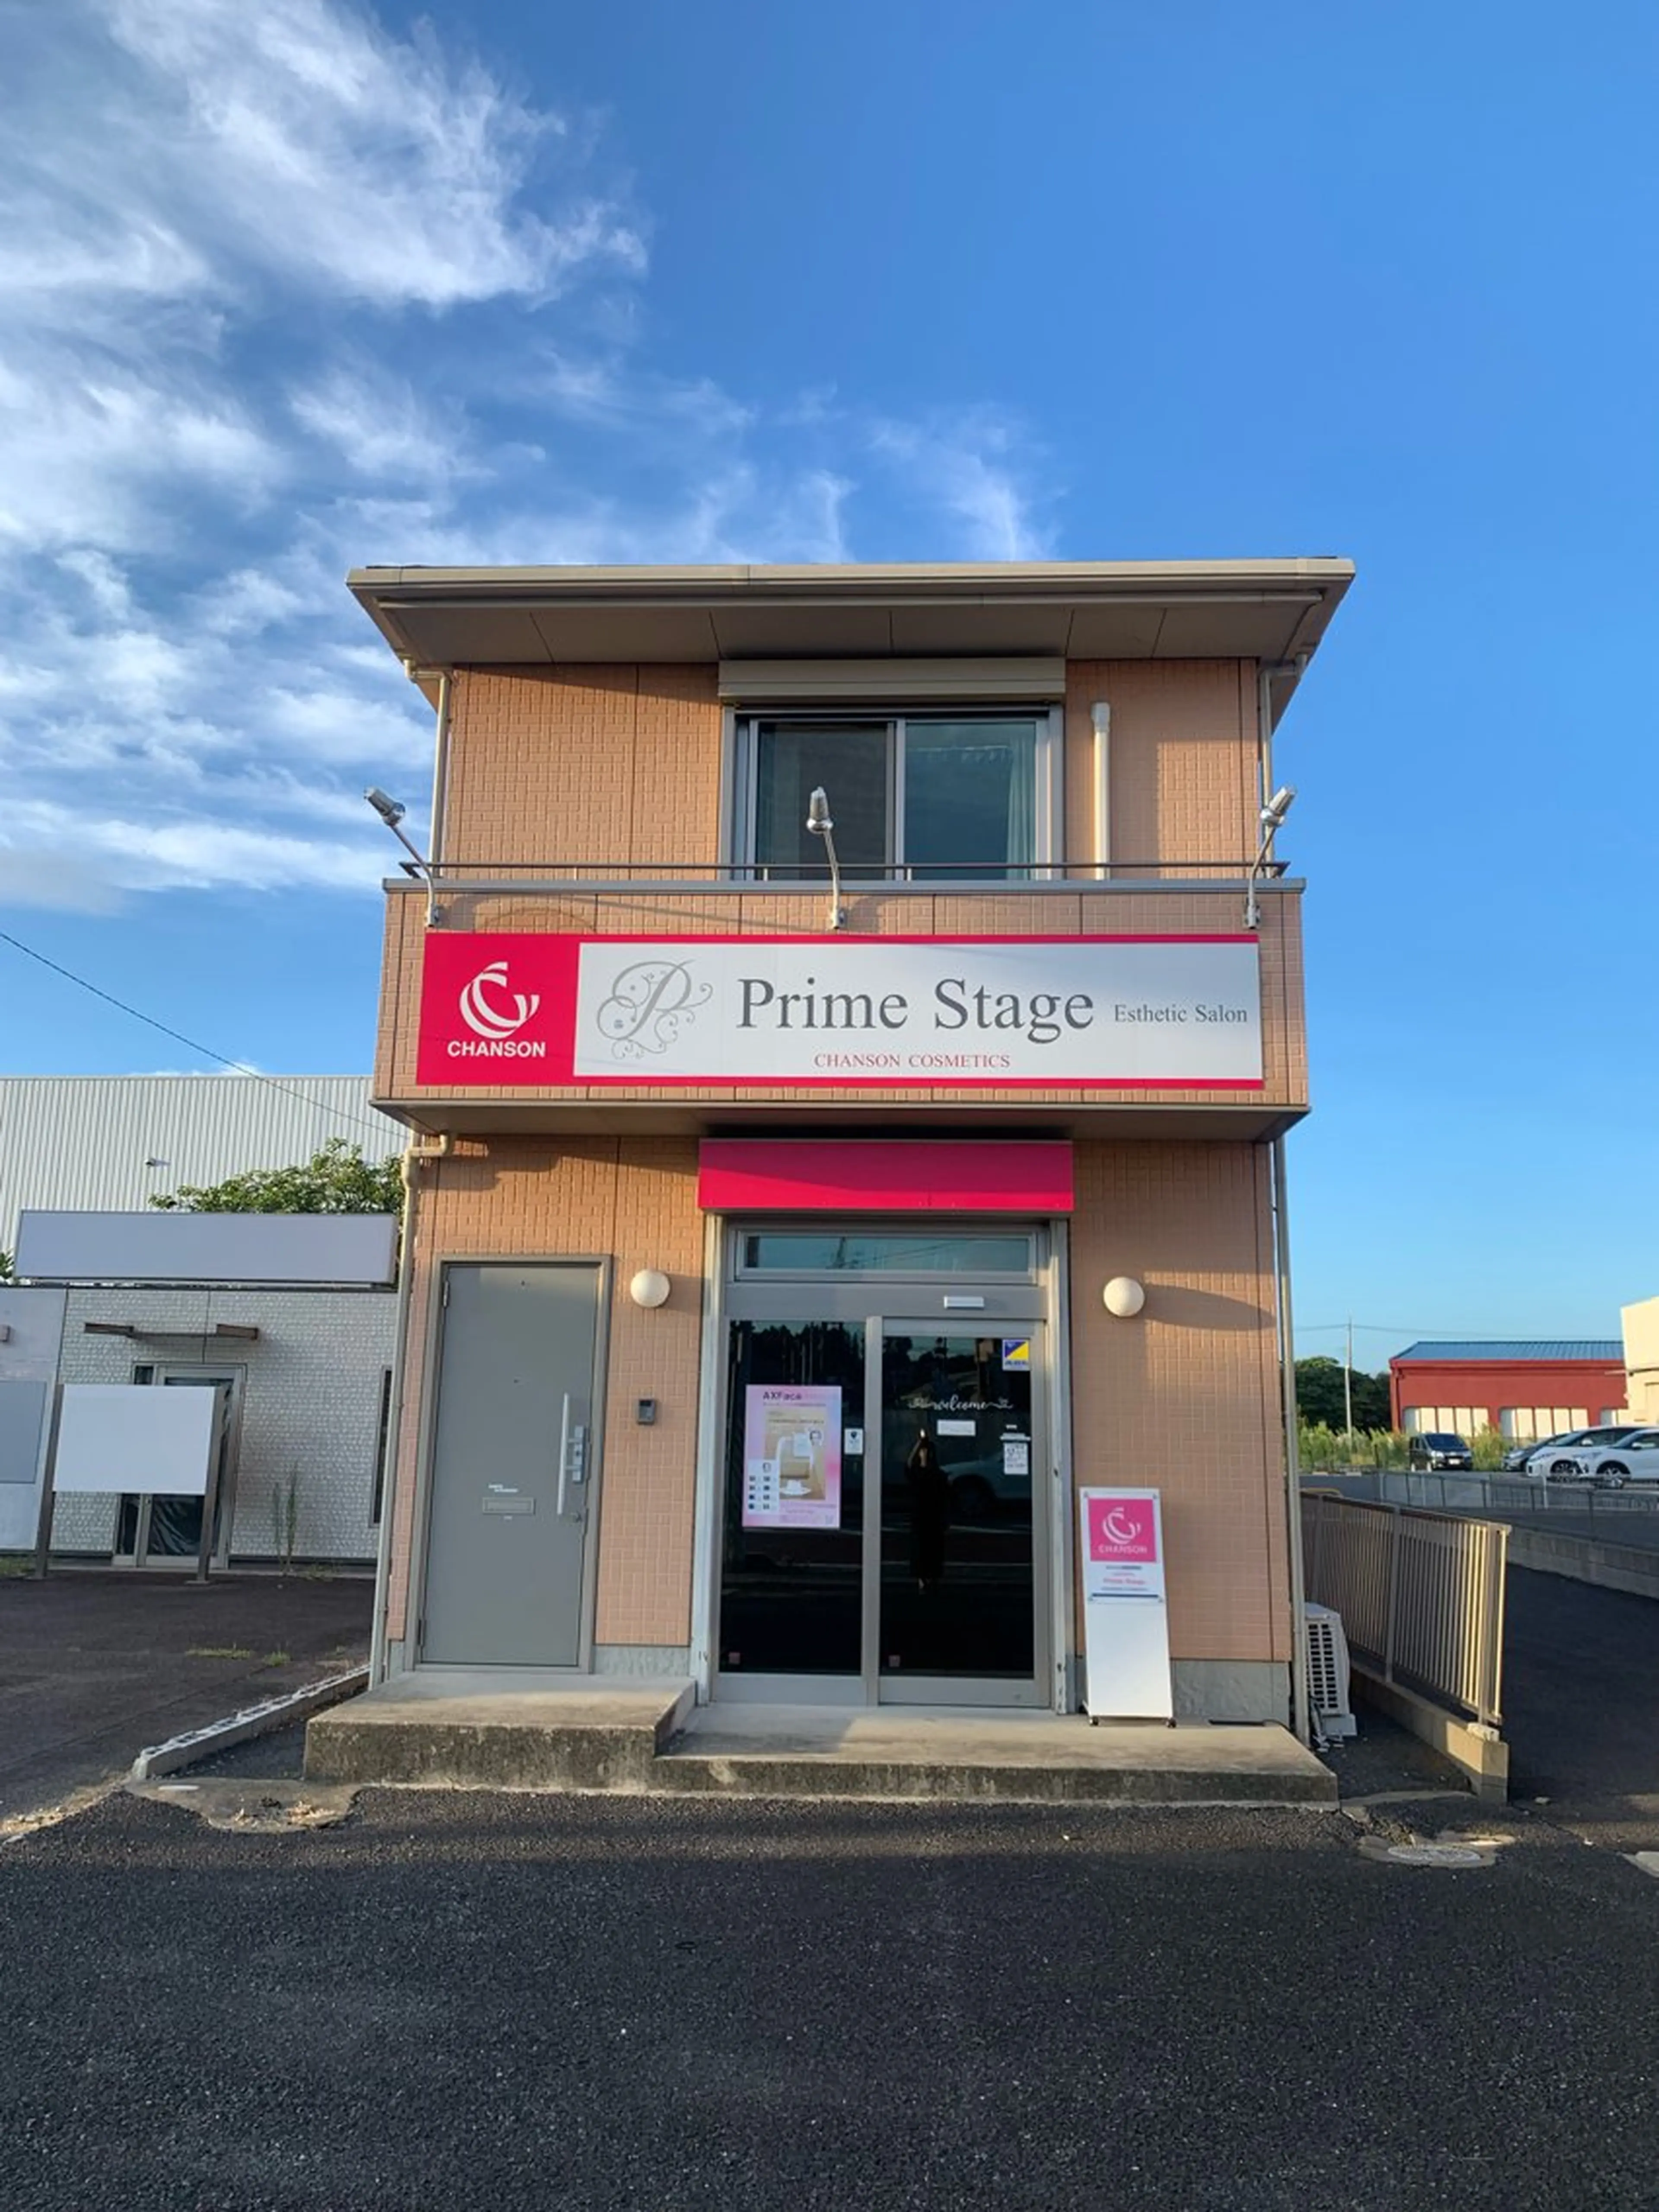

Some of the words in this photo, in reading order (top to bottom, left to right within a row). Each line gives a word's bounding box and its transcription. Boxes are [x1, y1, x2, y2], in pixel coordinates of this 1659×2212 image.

[736, 977, 908, 1029] Prime
[934, 978, 1094, 1044] Stage
[1115, 1004, 1187, 1023] Esthetic
[1195, 1004, 1248, 1023] Salon
[447, 1040, 546, 1058] CHANSON
[814, 1053, 901, 1068] CHANSON
[908, 1054, 1011, 1068] COSMETICS
[1098, 1543, 1148, 1554] CHANSON
